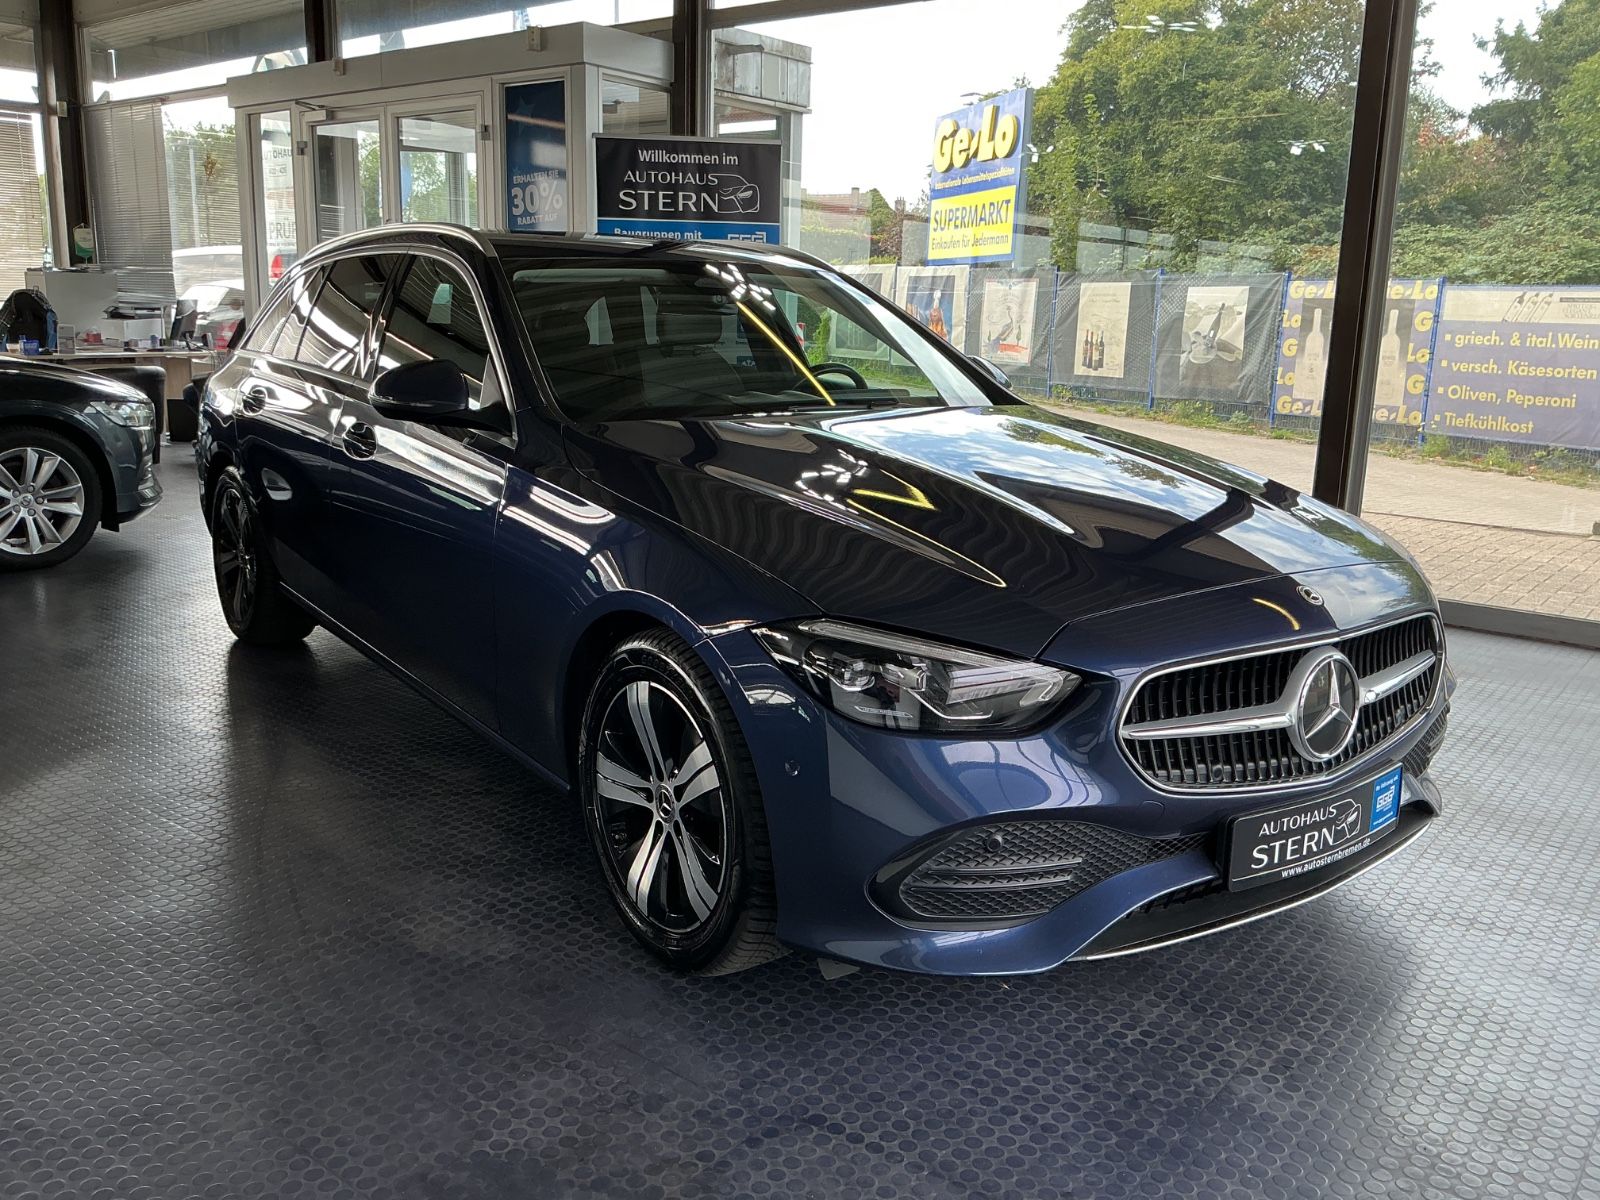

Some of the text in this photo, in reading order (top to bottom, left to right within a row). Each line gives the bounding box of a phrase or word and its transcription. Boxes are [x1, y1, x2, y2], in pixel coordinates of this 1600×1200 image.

[638, 150, 739, 165] Willkommen im
[513, 170, 559, 184] ERHALTEN SIE
[624, 170, 718, 186] AUTOHAUS
[512, 180, 563, 216] 30%
[618, 190, 718, 213] STERN
[517, 213, 558, 225] RABATT AUF
[933, 199, 1011, 232] SUPERMARKT
[684, 229, 702, 240] mit
[931, 232, 1009, 250] Einkaufen für Jedermann
[1289, 280, 1336, 299] Ge-L
[1387, 280, 1438, 300] e-Lo
[1282, 309, 1301, 328] Lo
[1455, 330, 1505, 347] griech.
[1510, 332, 1521, 347] &
[1407, 342, 1430, 363] Lo
[1276, 367, 1296, 385] Lo
[1451, 358, 1597, 380] versch. Käsesorten
[1277, 395, 1321, 416] Ge-L
[1447, 384, 1577, 408] Oliven, Peperoni
[1373, 405, 1422, 426] e-Lo
[1444, 412, 1534, 434] Tiefkühlkost
[1258, 806, 1337, 838] AUTOHAUS
[1251, 825, 1335, 869] STERN
[1282, 838, 1371, 878] www.autosternbremen.de
